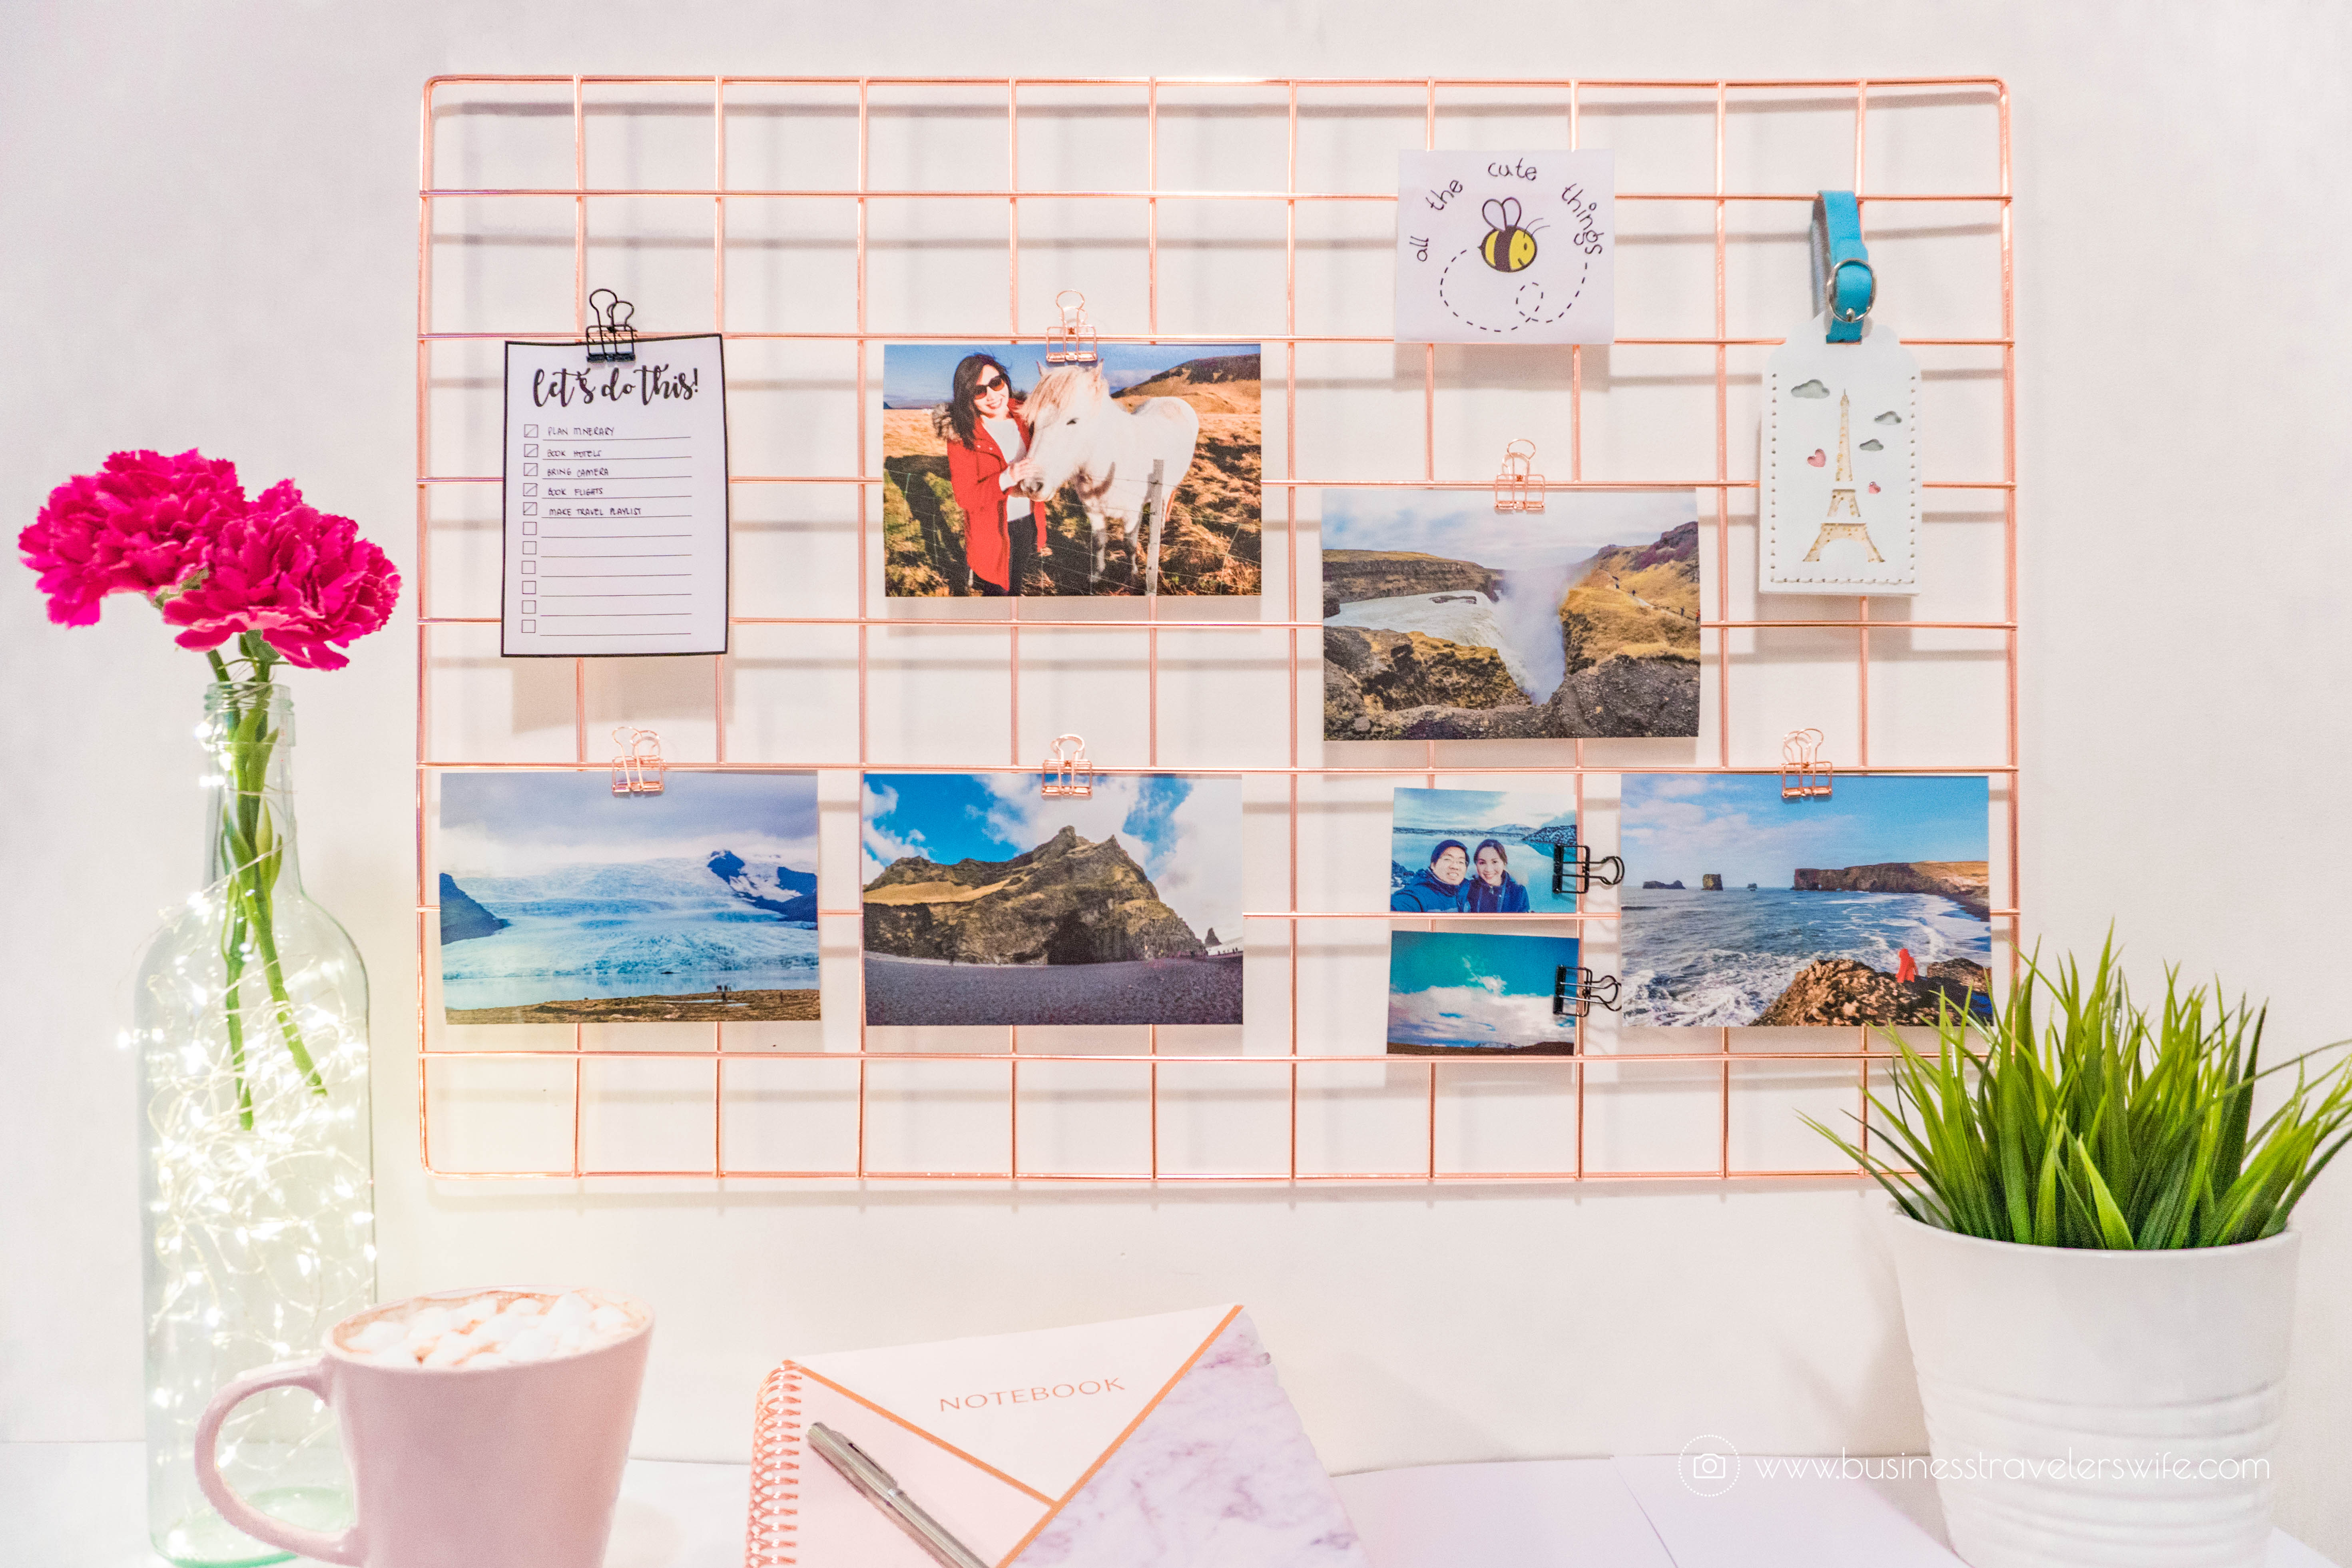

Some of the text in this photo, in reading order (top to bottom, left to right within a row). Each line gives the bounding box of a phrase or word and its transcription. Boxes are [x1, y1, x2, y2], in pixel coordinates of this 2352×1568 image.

[1409, 157, 1605, 262] all the cute things
[533, 363, 698, 407] let's do this!
[548, 426, 568, 436] PLAN
[547, 467, 609, 477] BRING CAMERA
[548, 487, 566, 496] BOOK
[940, 1377, 1125, 1412] NOTEBOOK
